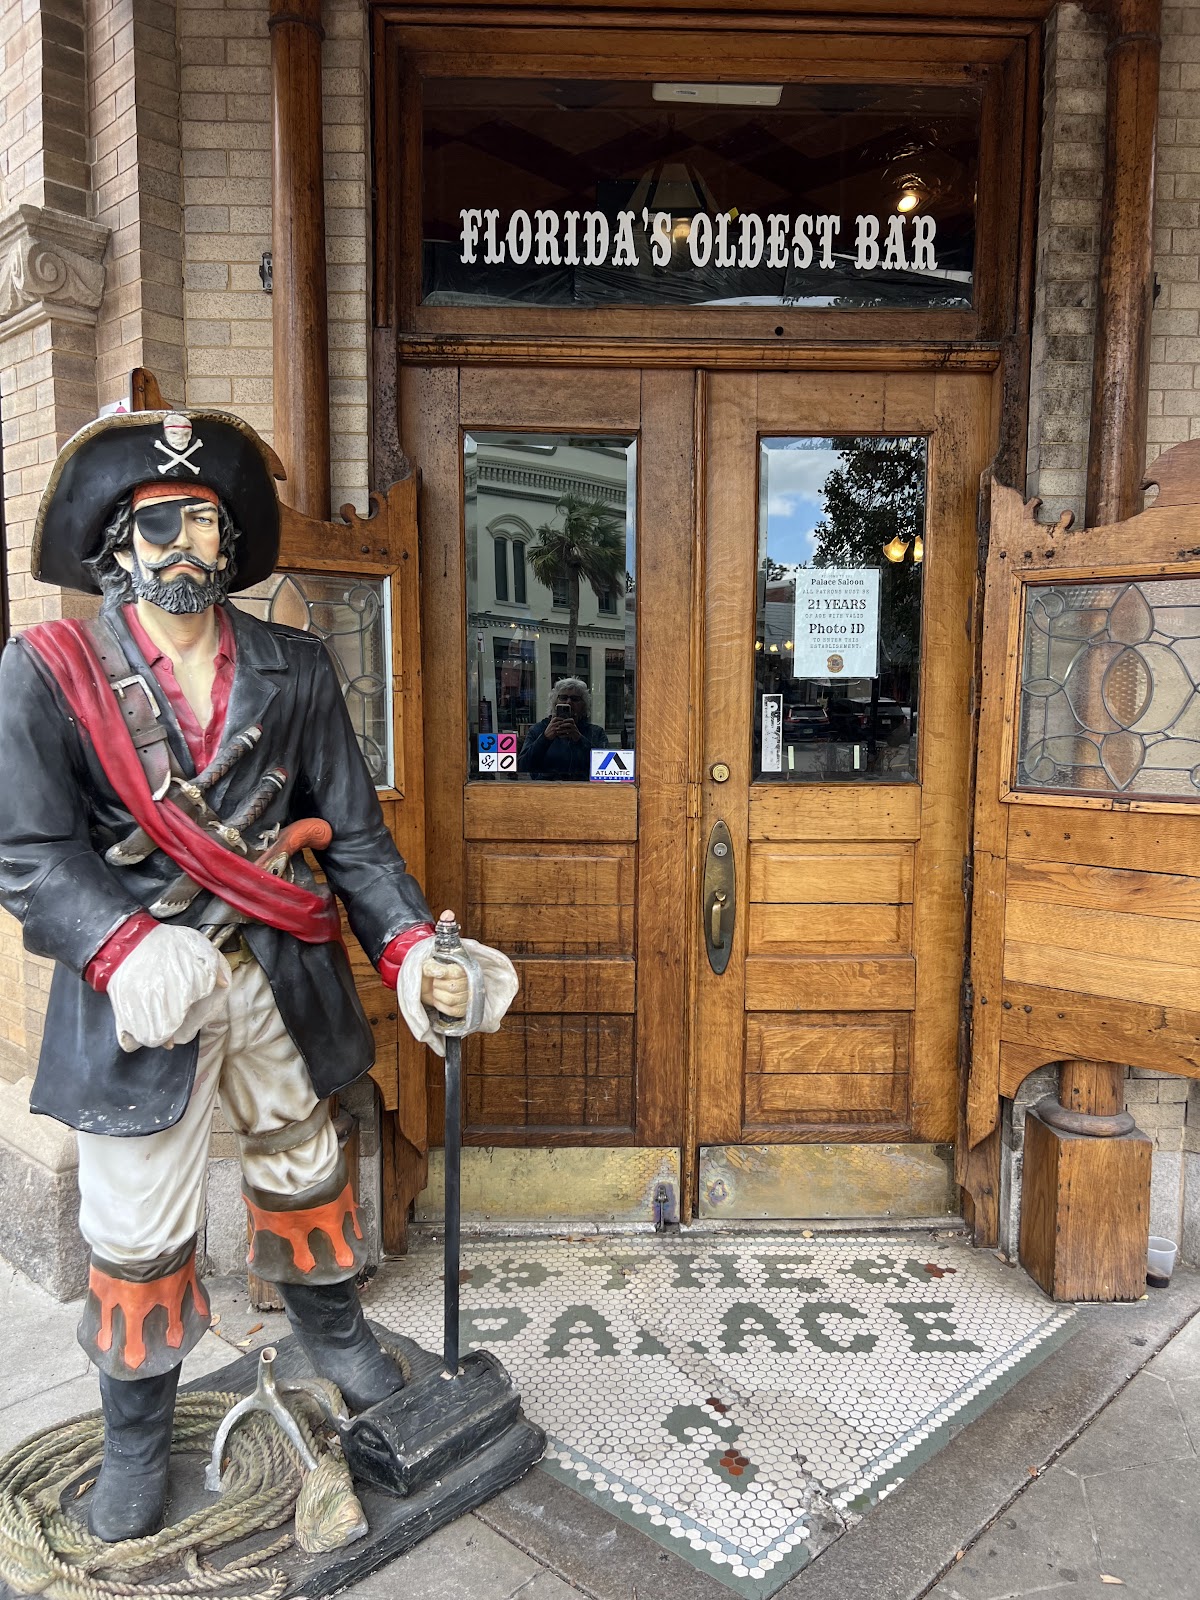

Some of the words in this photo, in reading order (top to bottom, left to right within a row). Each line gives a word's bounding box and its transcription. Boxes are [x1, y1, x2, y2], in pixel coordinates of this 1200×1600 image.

[459, 207, 672, 267] FLORIDA'S
[686, 212, 841, 269] OLDEST
[854, 214, 939, 270] BAR
[811, 578, 836, 586] Palace
[837, 578, 864, 586] Saloon
[808, 599, 821, 610] 21
[823, 599, 867, 610] YEARS
[809, 623, 847, 634] Photo
[851, 623, 865, 634] ID
[480, 735, 496, 751] 3
[481, 754, 495, 770] SA
[578, 1253, 829, 1294] THE
